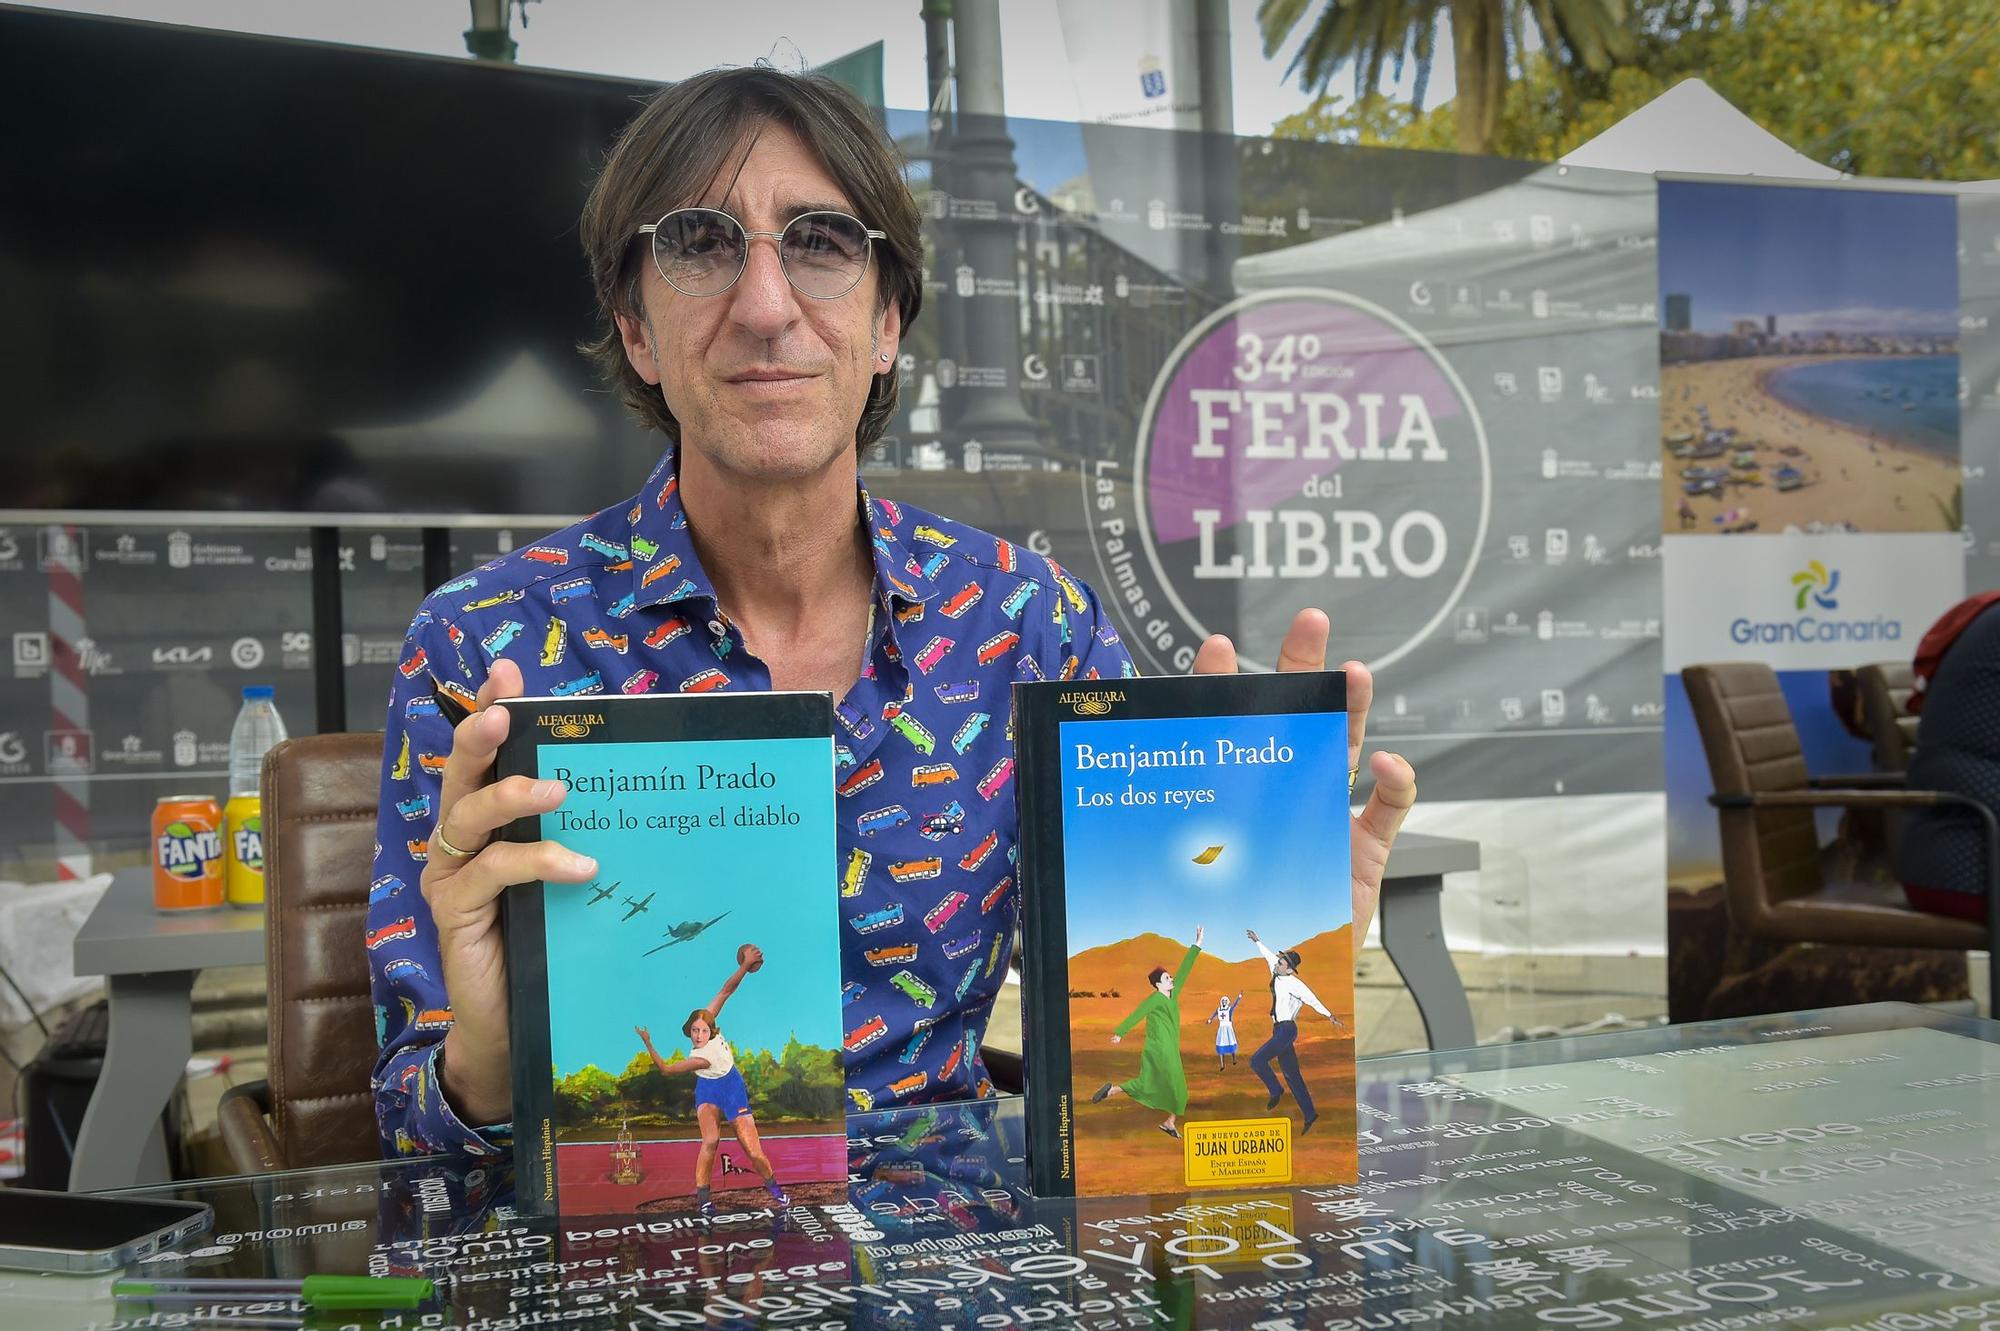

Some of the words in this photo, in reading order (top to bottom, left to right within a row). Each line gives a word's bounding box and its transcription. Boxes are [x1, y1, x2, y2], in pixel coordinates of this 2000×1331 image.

[1190, 389, 1447, 461] FERIA
[1095, 460, 1119, 511] Las
[1303, 475, 1342, 498] del
[1193, 510, 1447, 579] LIBRO
[1101, 519, 1150, 620] Palmas
[1146, 616, 1174, 652] de
[1730, 616, 1901, 645] GranCanaria
[1059, 690, 1126, 704] ALFAGUARA
[536, 714, 605, 726] ALFAGUARA
[1074, 741, 1206, 777] Benjamín
[1216, 736, 1294, 764] Prado
[553, 765, 687, 801] Benjamín
[696, 762, 776, 791] Prado
[1076, 786, 1114, 808] Los
[1121, 784, 1157, 806] dos
[1164, 787, 1216, 810] reyes
[554, 809, 611, 832] Todo
[618, 808, 638, 830] lo
[646, 812, 701, 836] carga
[708, 807, 727, 828] el
[733, 805, 801, 827] diablo
[1059, 1094, 1069, 1137] Hispánica
[1212, 1131, 1240, 1139] NUEVO
[1244, 1130, 1265, 1138] CASO
[1269, 1129, 1281, 1137] DE
[542, 1117, 554, 1161] Hispánica
[1061, 1138, 1071, 1179] Narrativa
[1195, 1141, 1228, 1157] JUAN
[1232, 1138, 1285, 1155] URBANO
[543, 1162, 554, 1202] Narrativa
